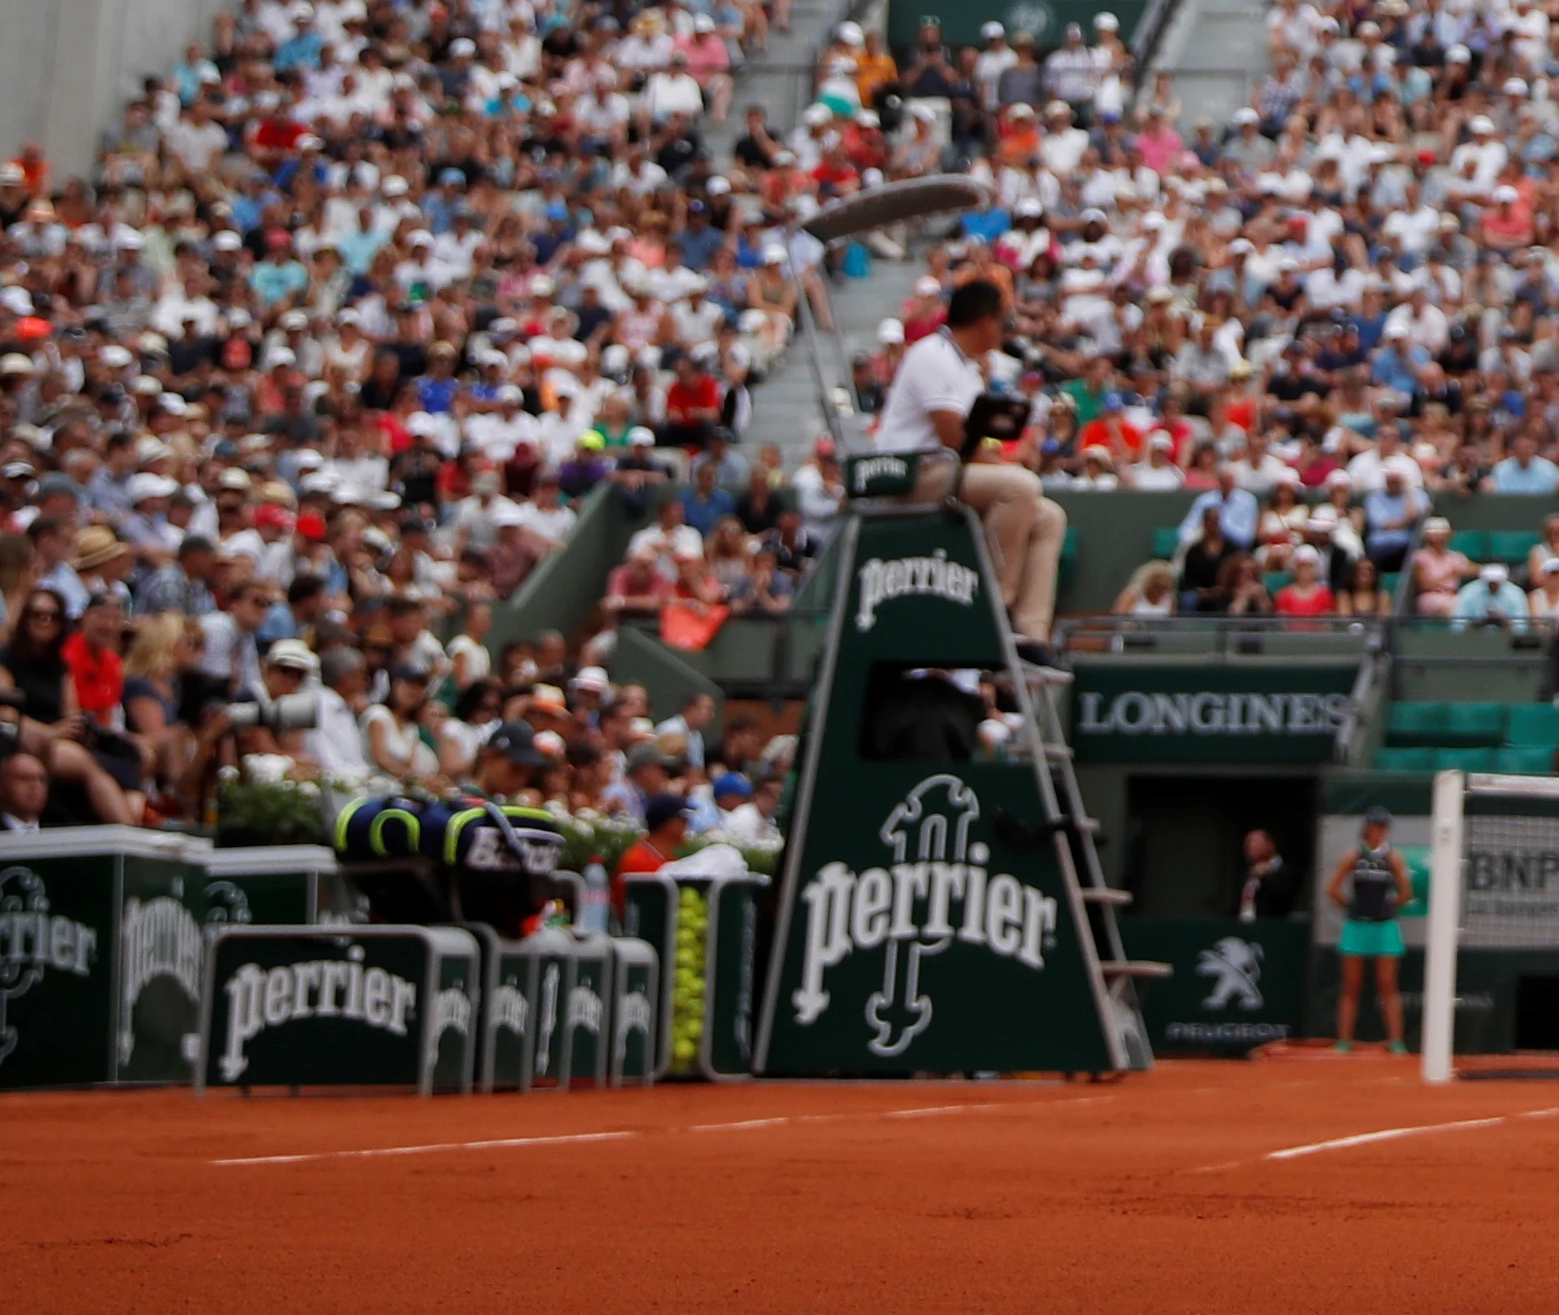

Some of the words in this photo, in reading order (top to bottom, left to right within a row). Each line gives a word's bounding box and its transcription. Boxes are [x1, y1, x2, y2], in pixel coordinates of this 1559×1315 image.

[855, 547, 980, 634] perrier
[1078, 690, 1349, 736] LONGINES
[790, 840, 1058, 1027] perrier
[218, 943, 417, 1083] perrier
